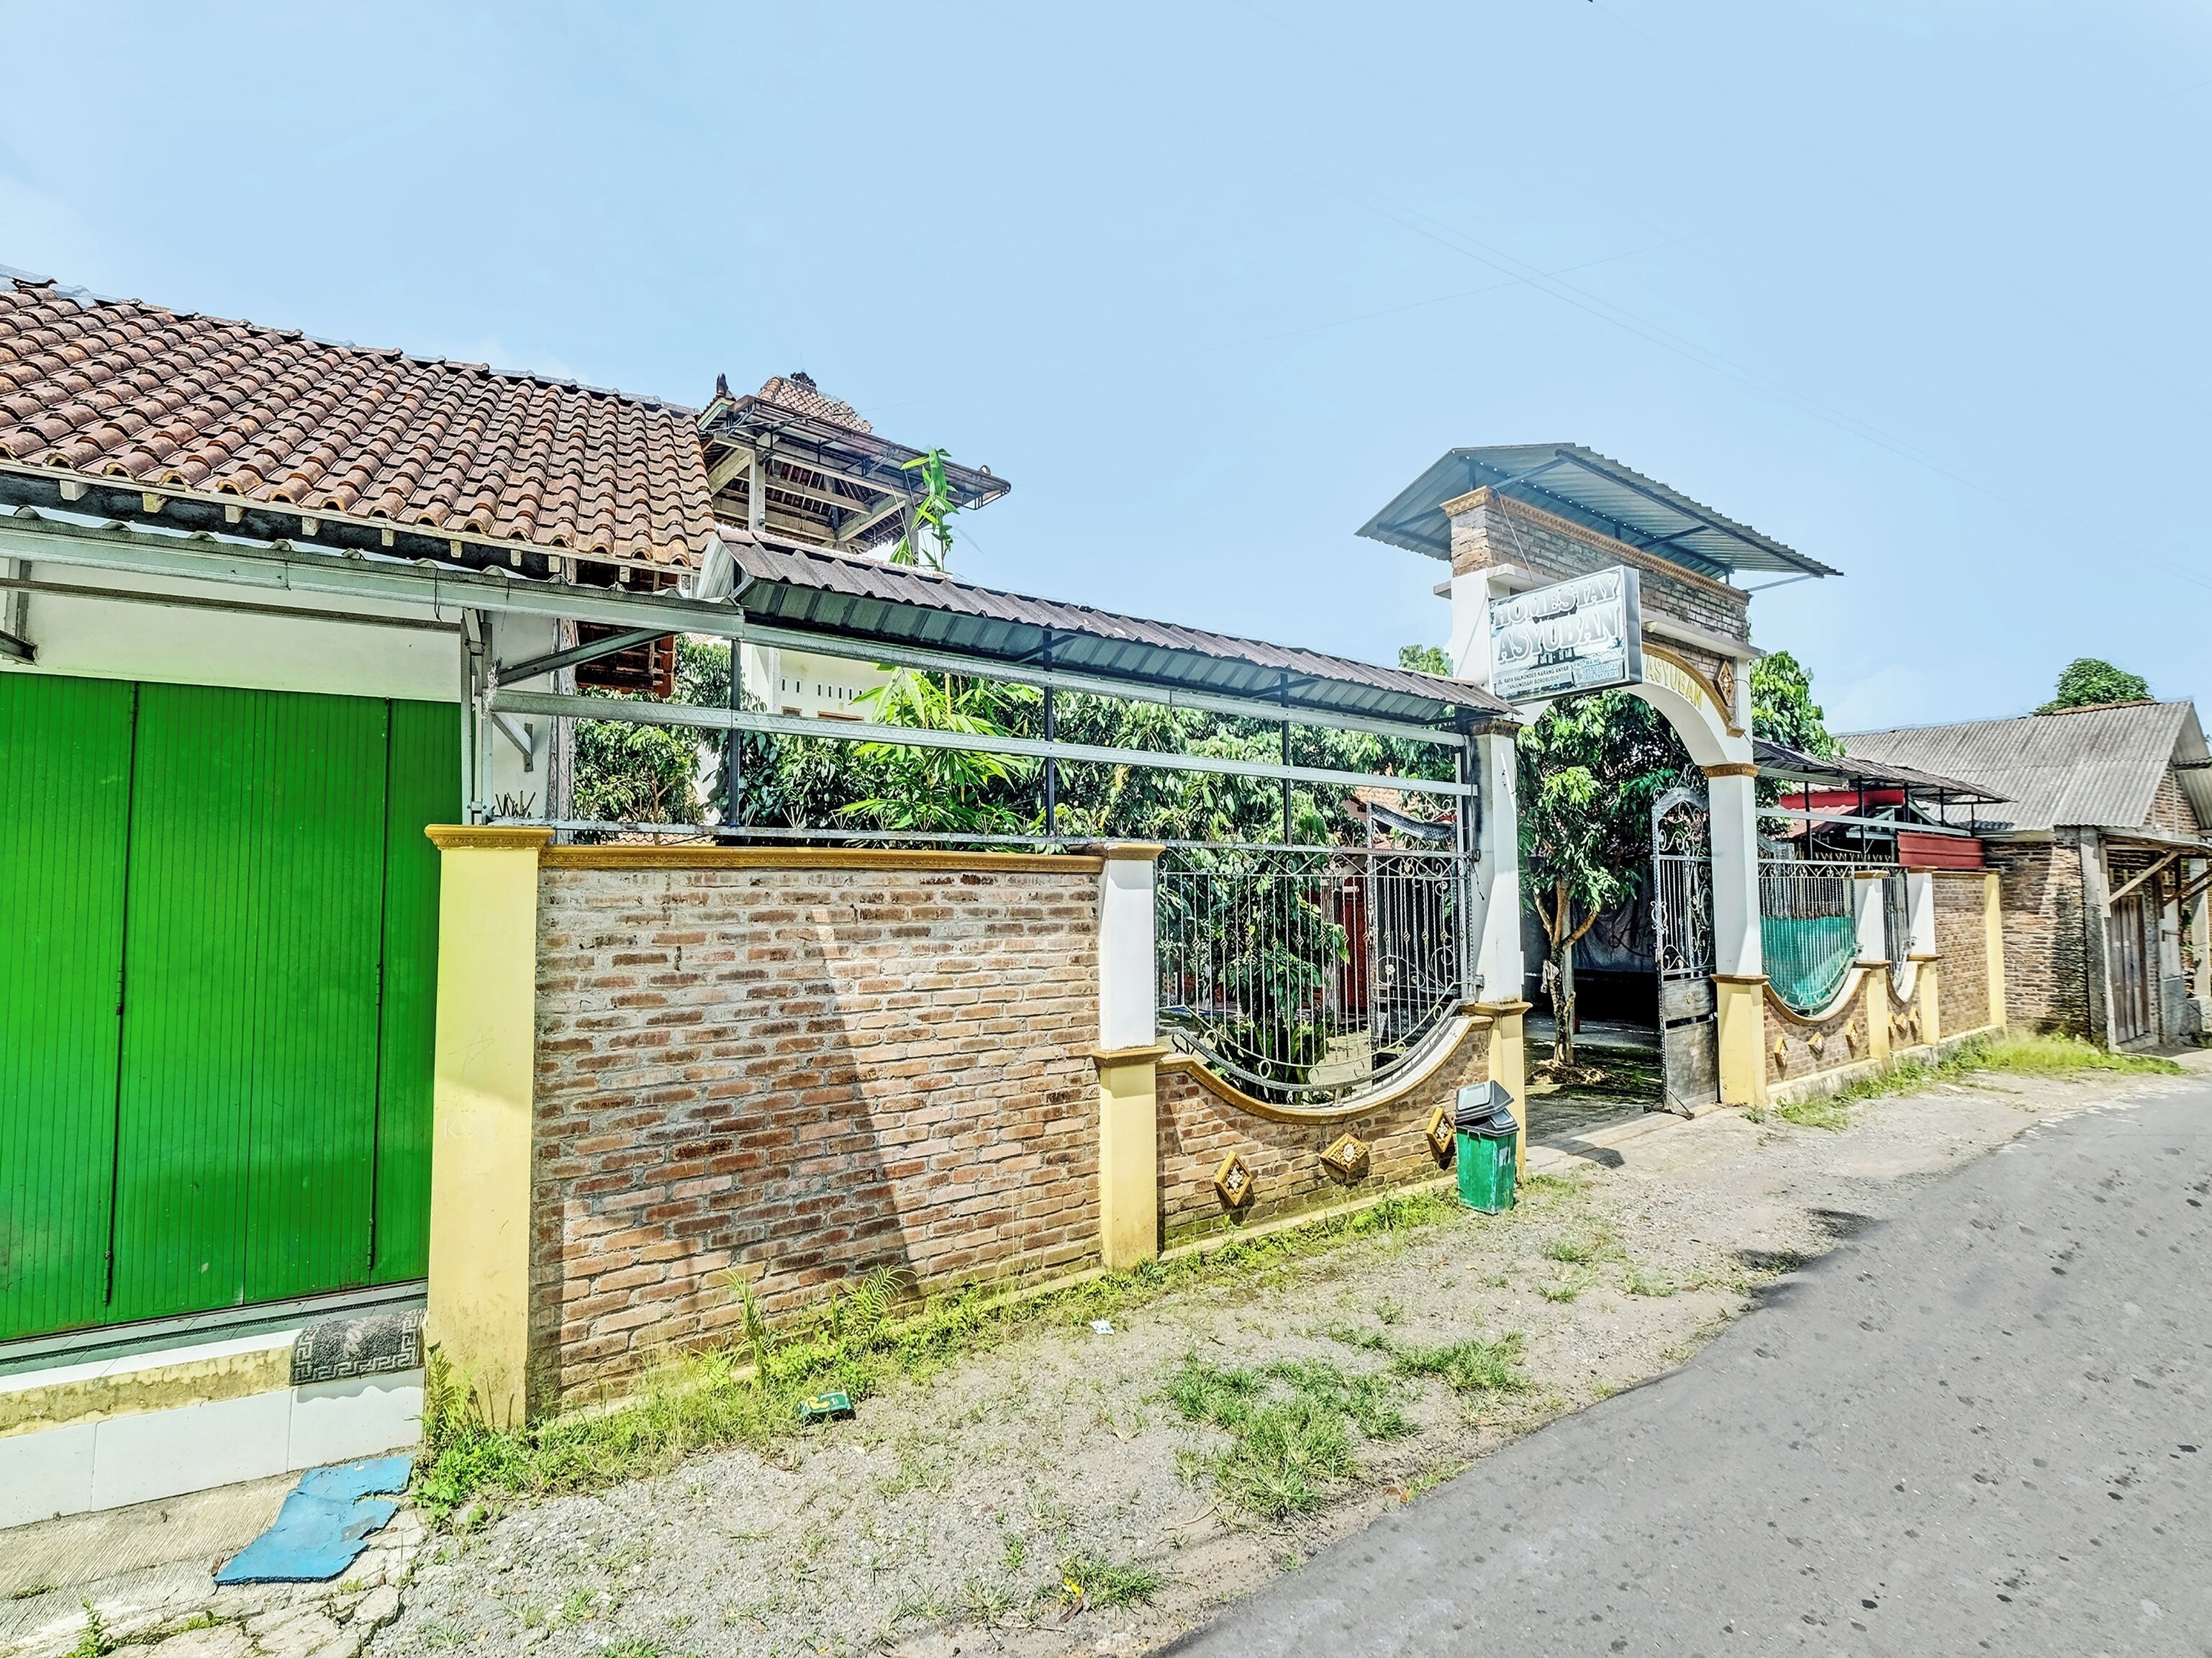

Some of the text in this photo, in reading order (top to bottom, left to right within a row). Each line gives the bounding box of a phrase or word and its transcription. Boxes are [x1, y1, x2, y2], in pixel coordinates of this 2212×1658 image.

[1494, 579, 1618, 628] HOMESTAY
[1497, 604, 1619, 663] ASYUBAN
[1646, 653, 1703, 710] ASYUBAN
